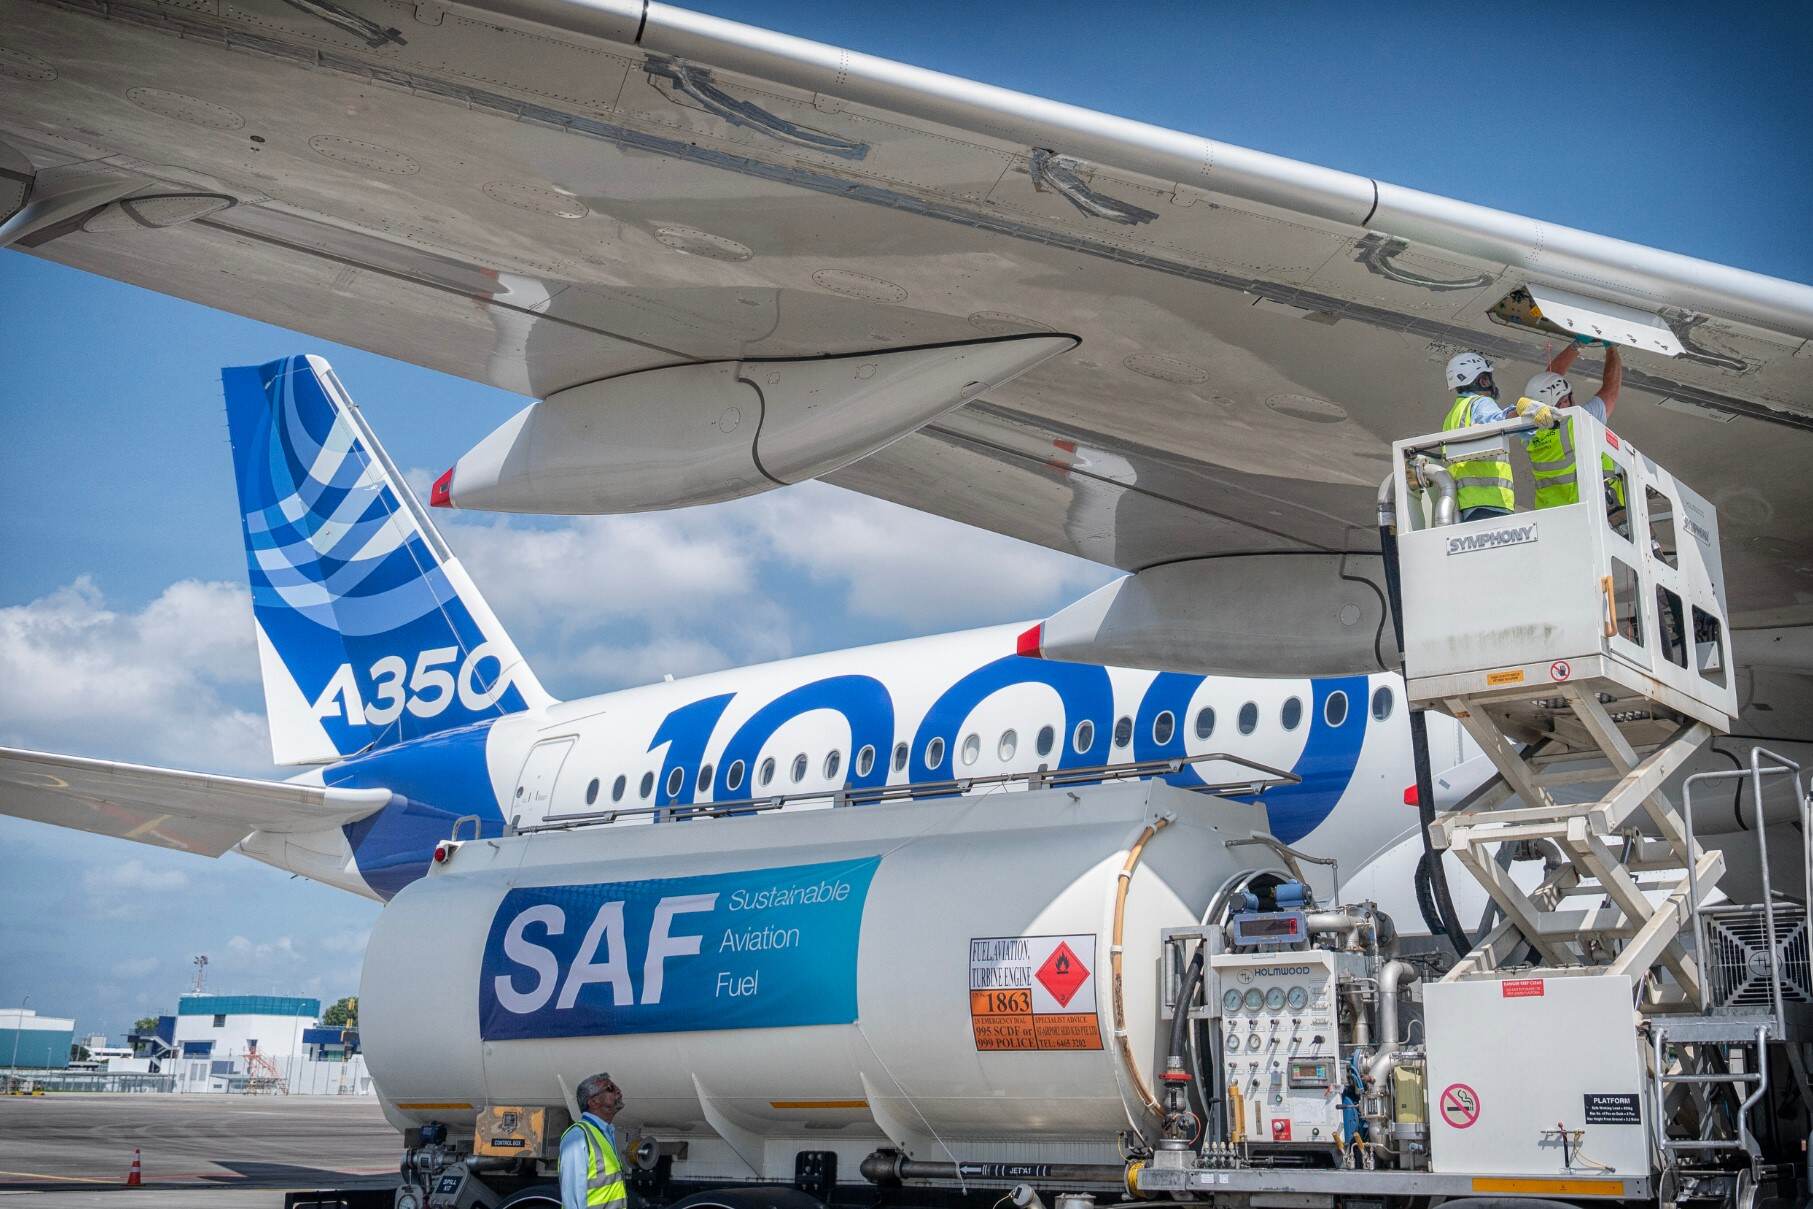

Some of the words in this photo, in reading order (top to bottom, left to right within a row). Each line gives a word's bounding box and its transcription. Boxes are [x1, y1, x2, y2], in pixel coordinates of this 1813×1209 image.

[1449, 526, 1533, 552] SYMPHONY
[311, 641, 513, 726] A350
[646, 654, 1369, 844] 1000
[729, 880, 850, 912] Sustainable
[719, 924, 799, 953] Aviation
[494, 892, 721, 1014] SAF
[715, 970, 759, 998] Fuel
[972, 967, 1003, 988] TURBINE
[1004, 966, 1031, 987] ENGINE
[1254, 967, 1310, 977] HOLMWOOD
[986, 992, 1030, 1013] 1863
[976, 1026, 992, 1037] 995
[993, 1025, 1020, 1037] SCDF
[1022, 1028, 1033, 1037] or
[977, 1038, 994, 1048] 999
[996, 1037, 1035, 1048] POLICE
